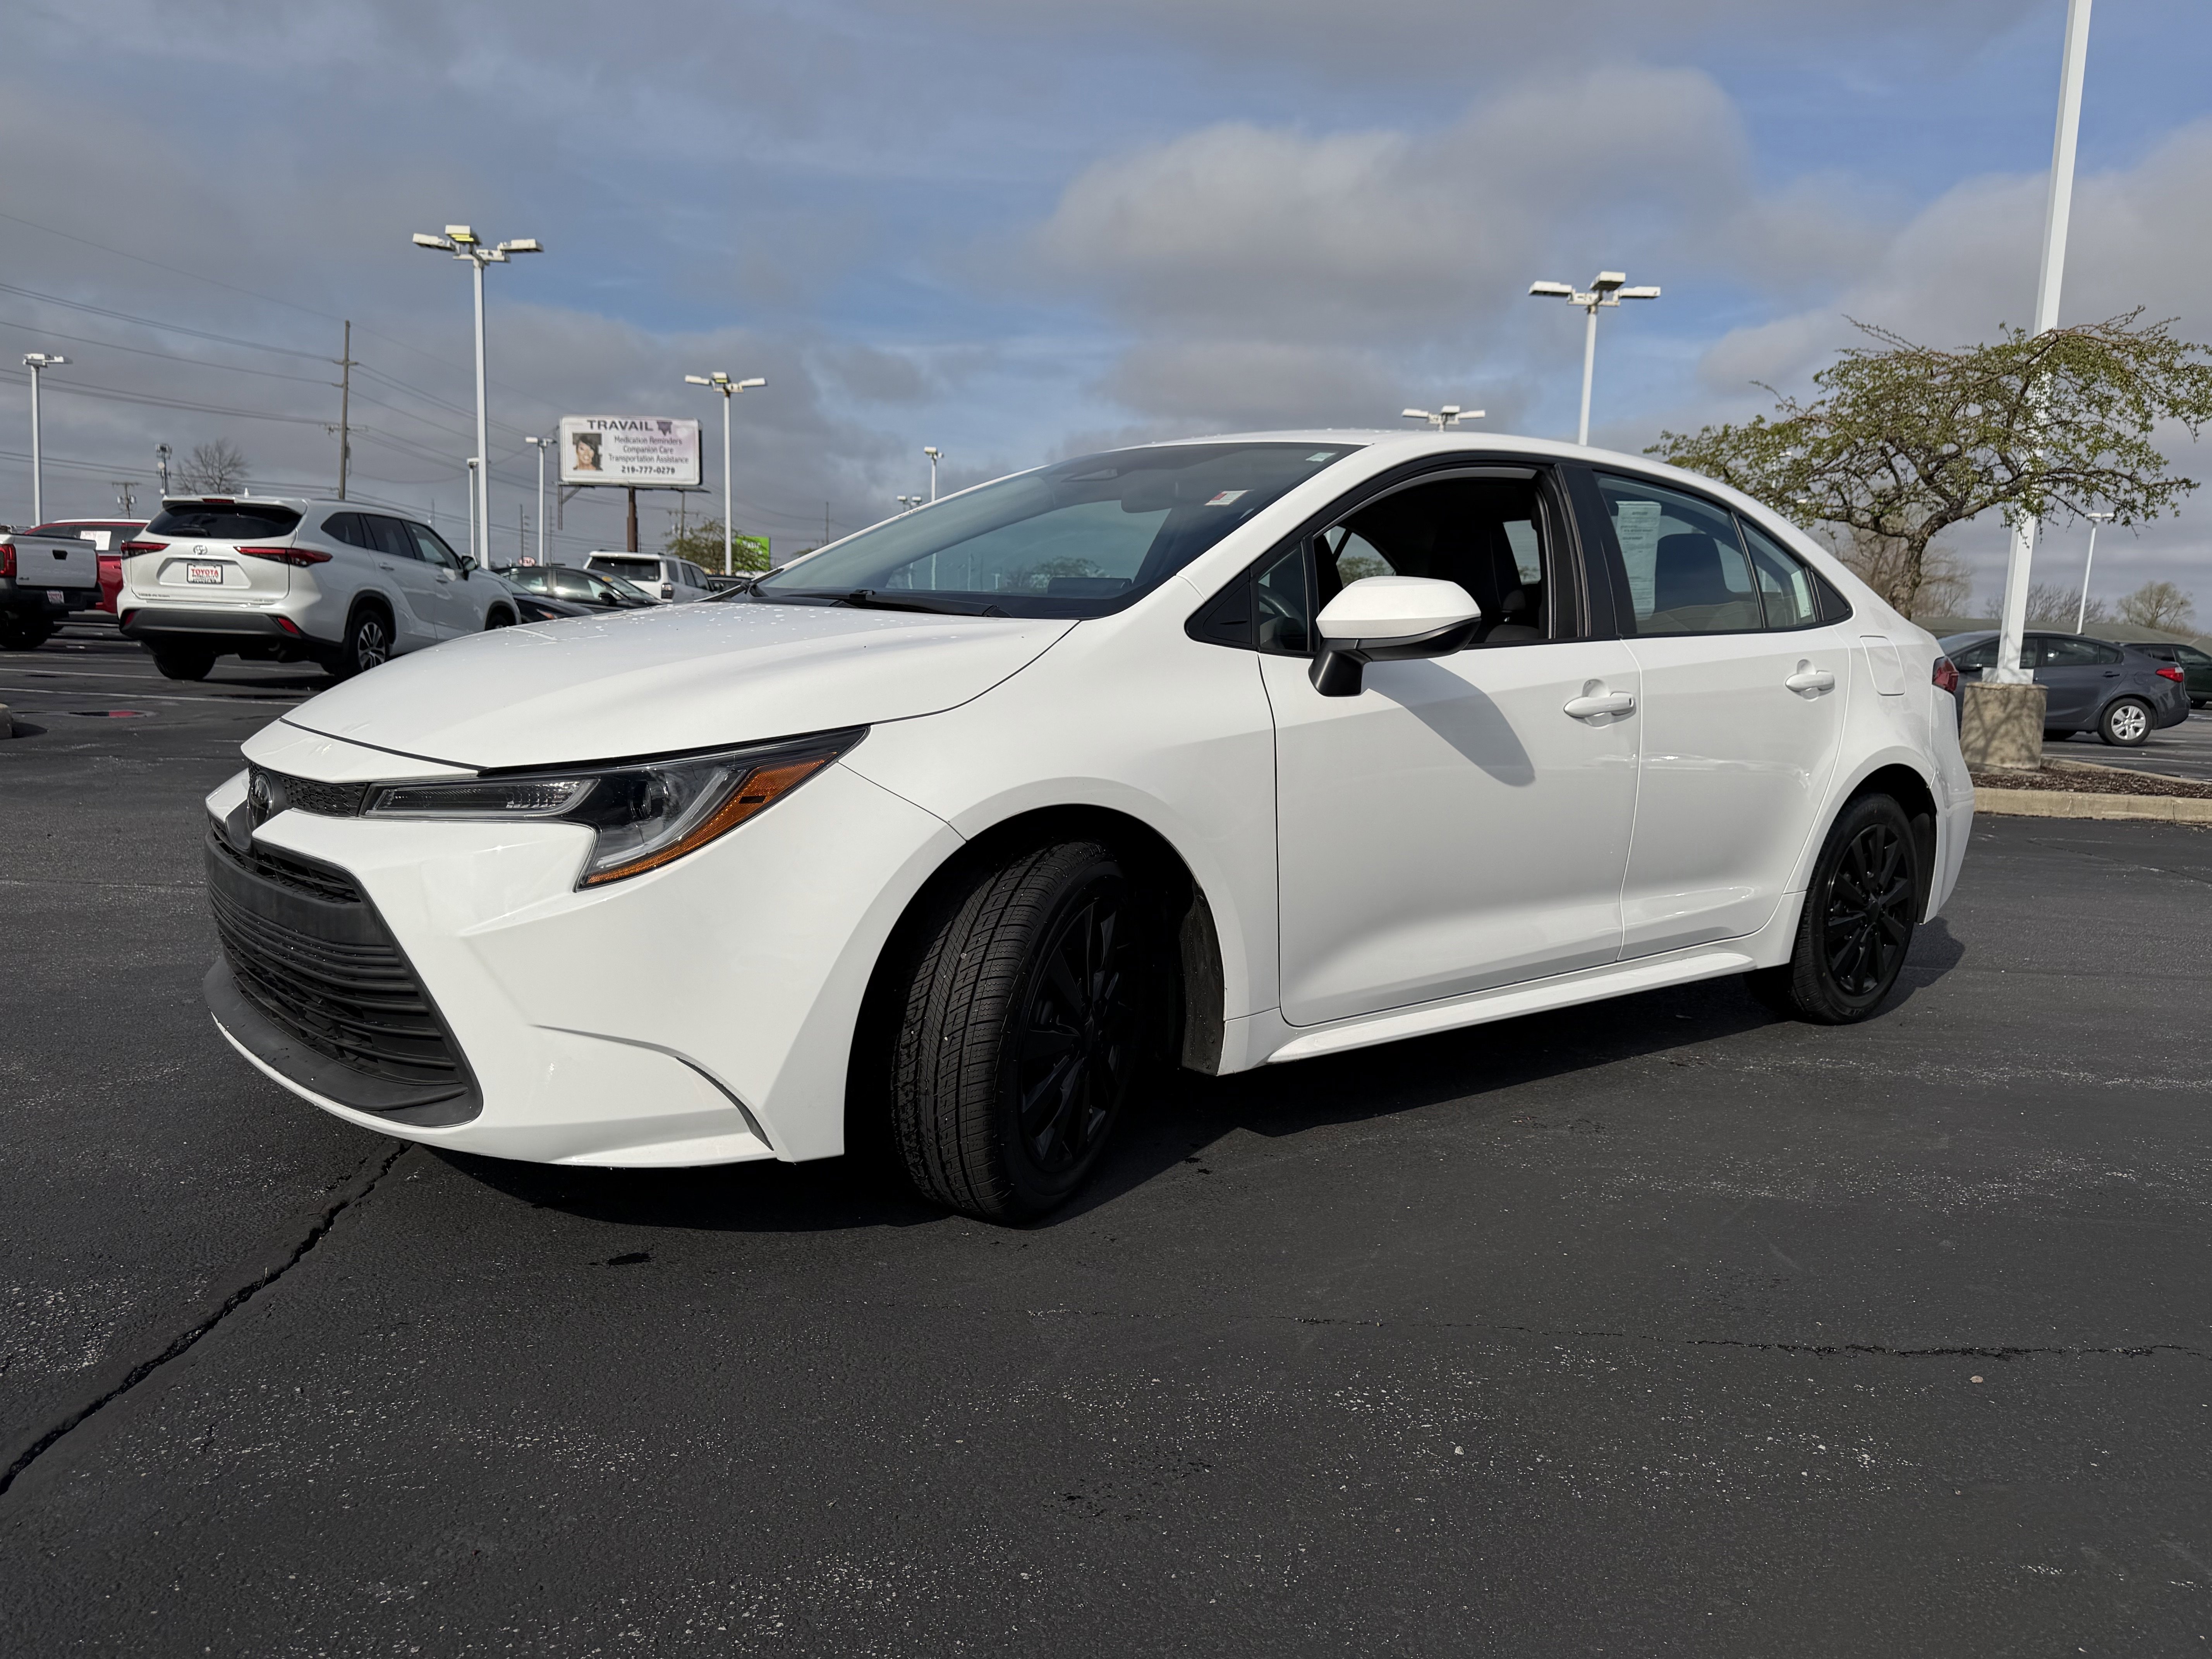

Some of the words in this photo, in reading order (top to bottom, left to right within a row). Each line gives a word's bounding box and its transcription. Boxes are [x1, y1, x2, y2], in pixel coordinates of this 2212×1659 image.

[588, 420, 653, 431] TRAVAIL
[650, 436, 682, 445] Reminders
[623, 445, 658, 455] Companion
[608, 453, 654, 463] Transportation
[656, 455, 689, 463] Assistance
[191, 568, 219, 577] TOYOTA
